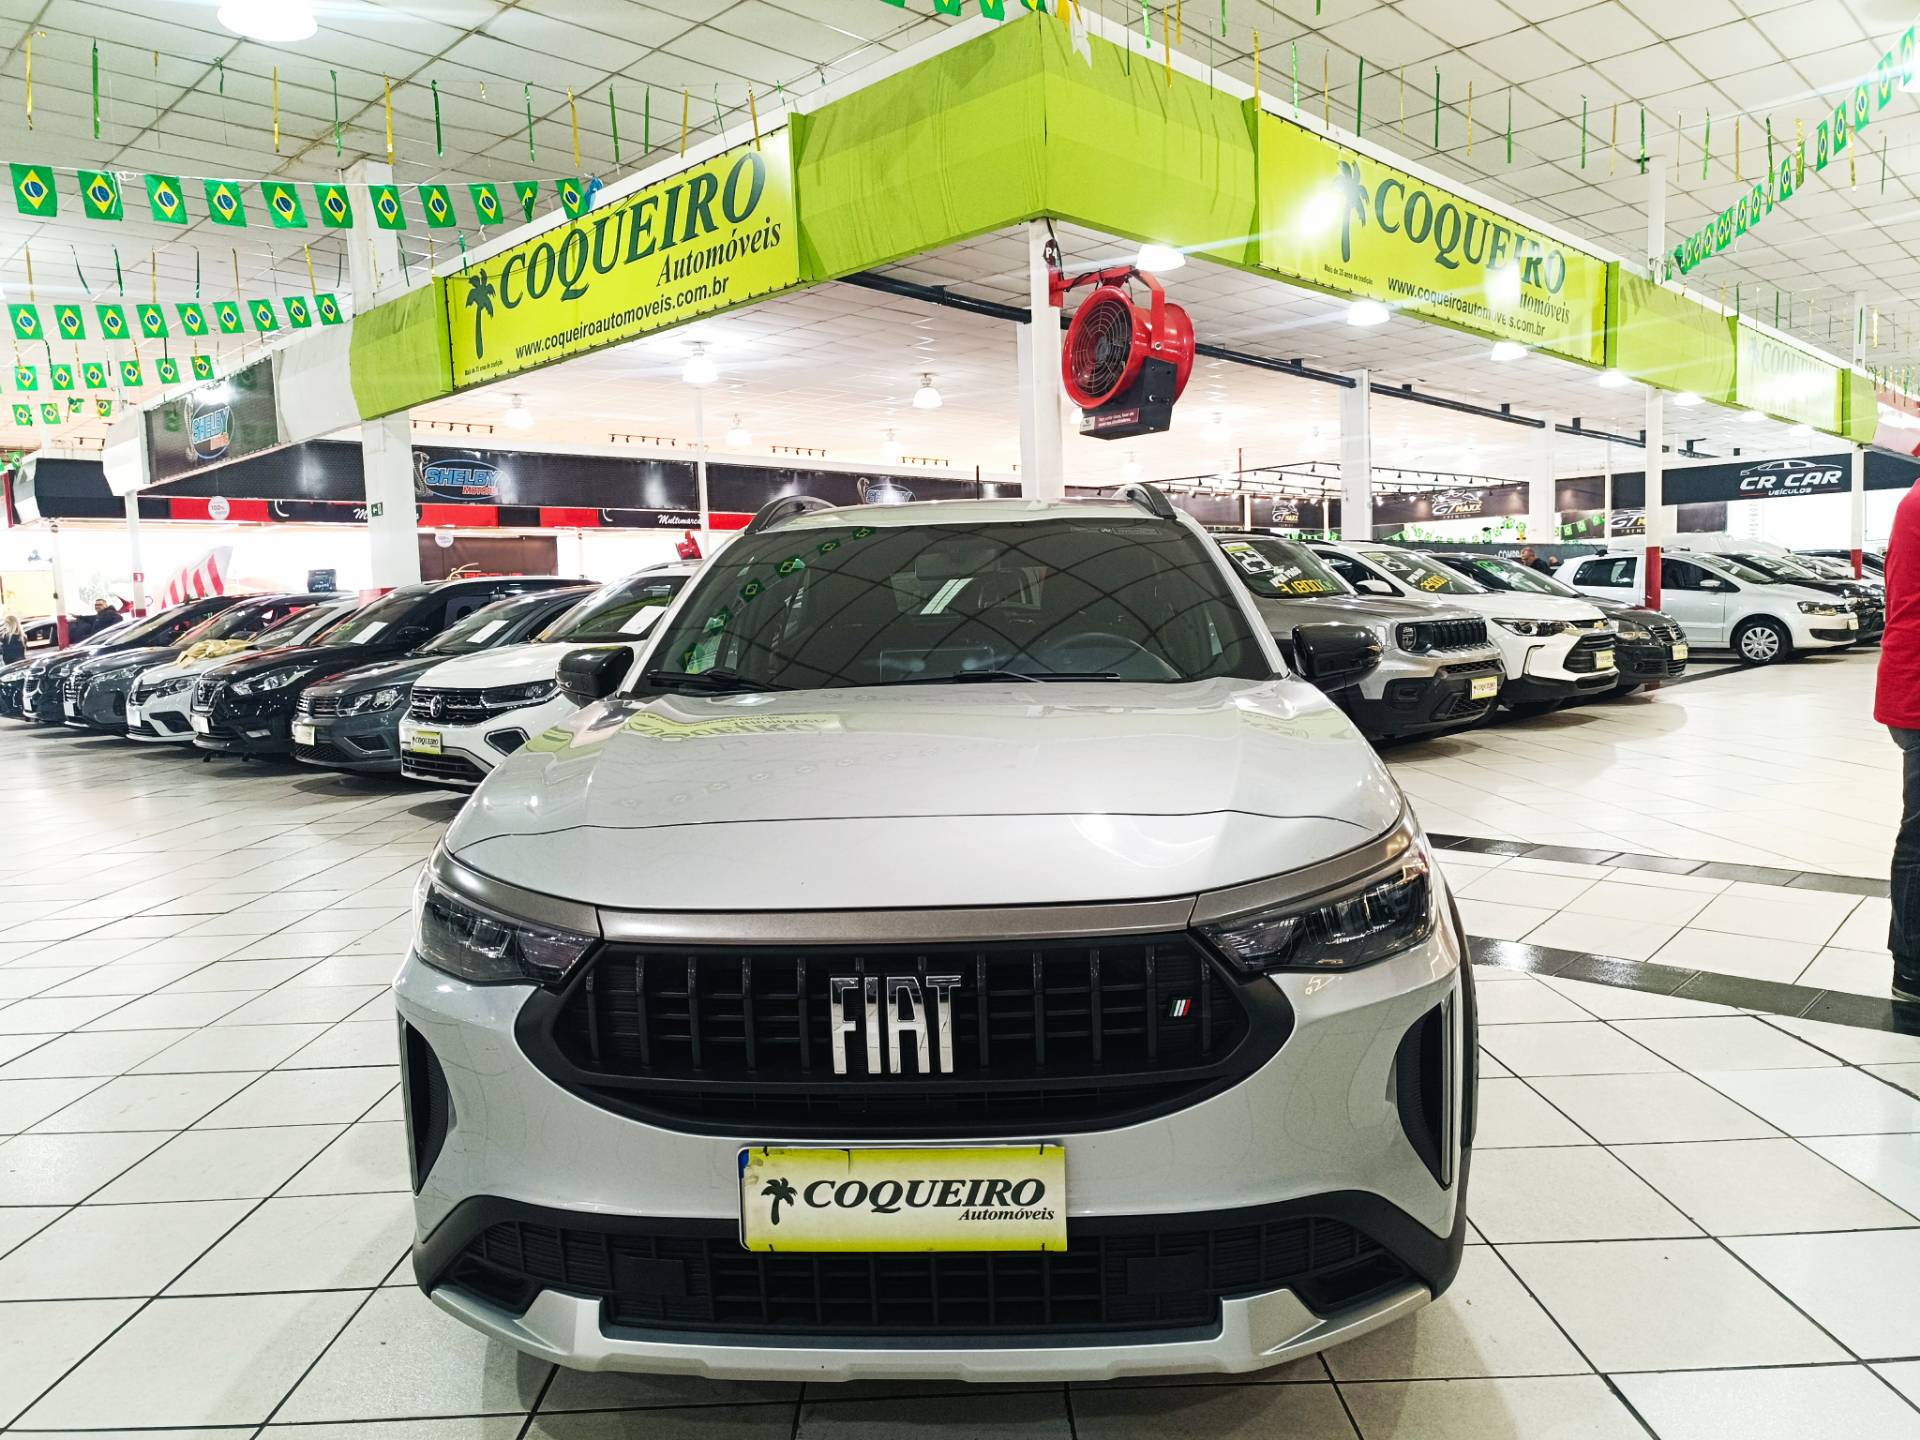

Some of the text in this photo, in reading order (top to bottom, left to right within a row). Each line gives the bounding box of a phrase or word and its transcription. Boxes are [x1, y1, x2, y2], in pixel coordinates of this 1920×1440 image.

[500, 152, 766, 309] COQUEIRO
[656, 216, 782, 287] Automóveis
[1374, 178, 1566, 294] COQUEIRO
[515, 276, 729, 360] www.coqueiroautomoveis.com.br
[424, 467, 503, 486] SHELBY
[1740, 470, 1842, 490] CR CAR
[830, 975, 962, 1074] FIAT
[803, 1178, 1046, 1213] COQUEIRO
[958, 1207, 1055, 1222] Automóveis
